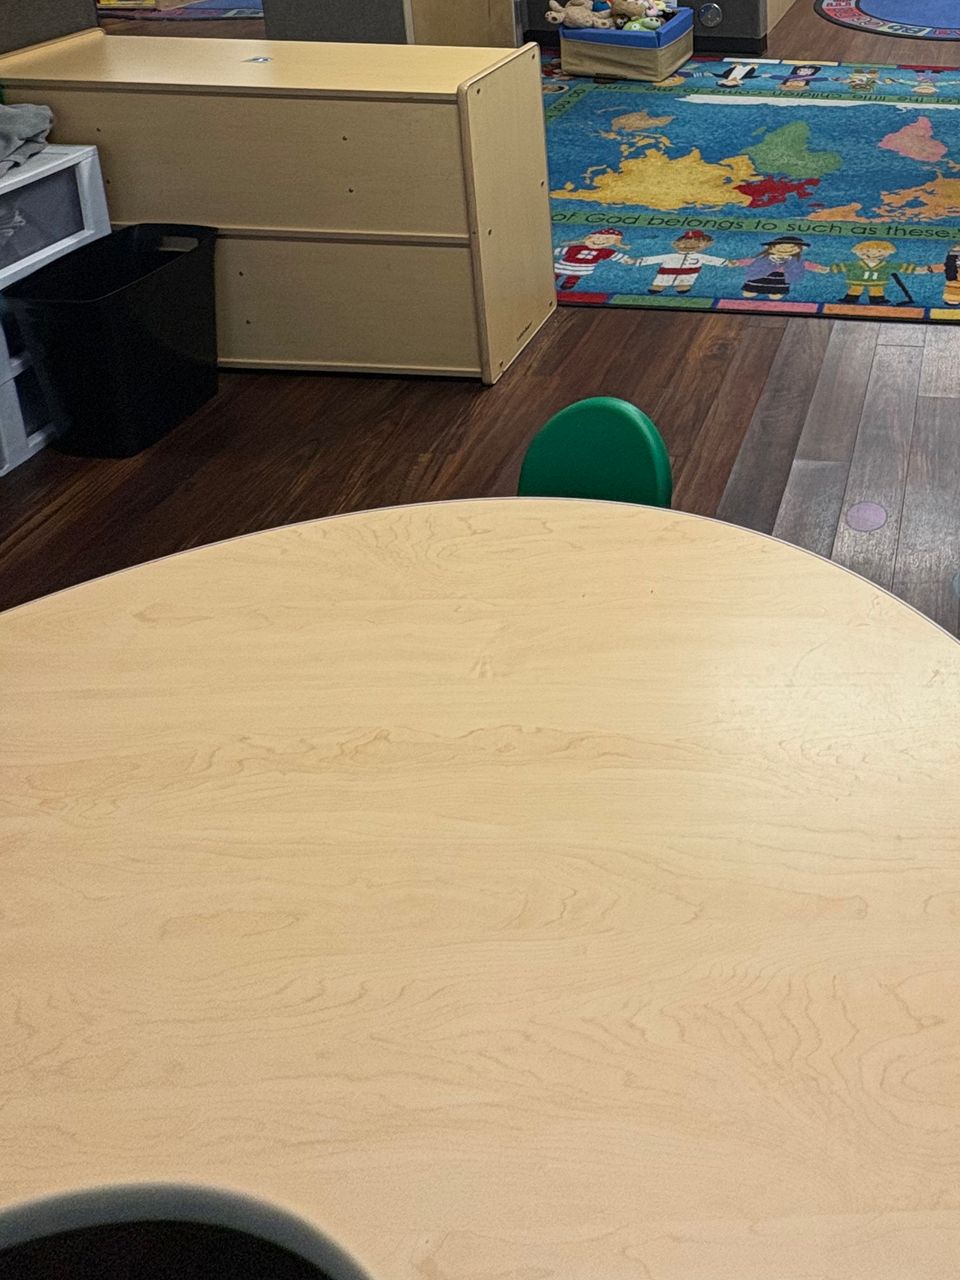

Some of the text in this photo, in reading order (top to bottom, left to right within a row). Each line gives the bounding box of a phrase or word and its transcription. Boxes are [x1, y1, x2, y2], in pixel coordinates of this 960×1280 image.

[709, 88, 762, 96] come
[771, 90, 842, 100] children
[551, 211, 573, 222] of
[585, 212, 641, 225] God
[647, 214, 744, 232] belongs
[754, 220, 778, 231] to
[785, 220, 843, 234] such
[850, 226, 878, 236] as
